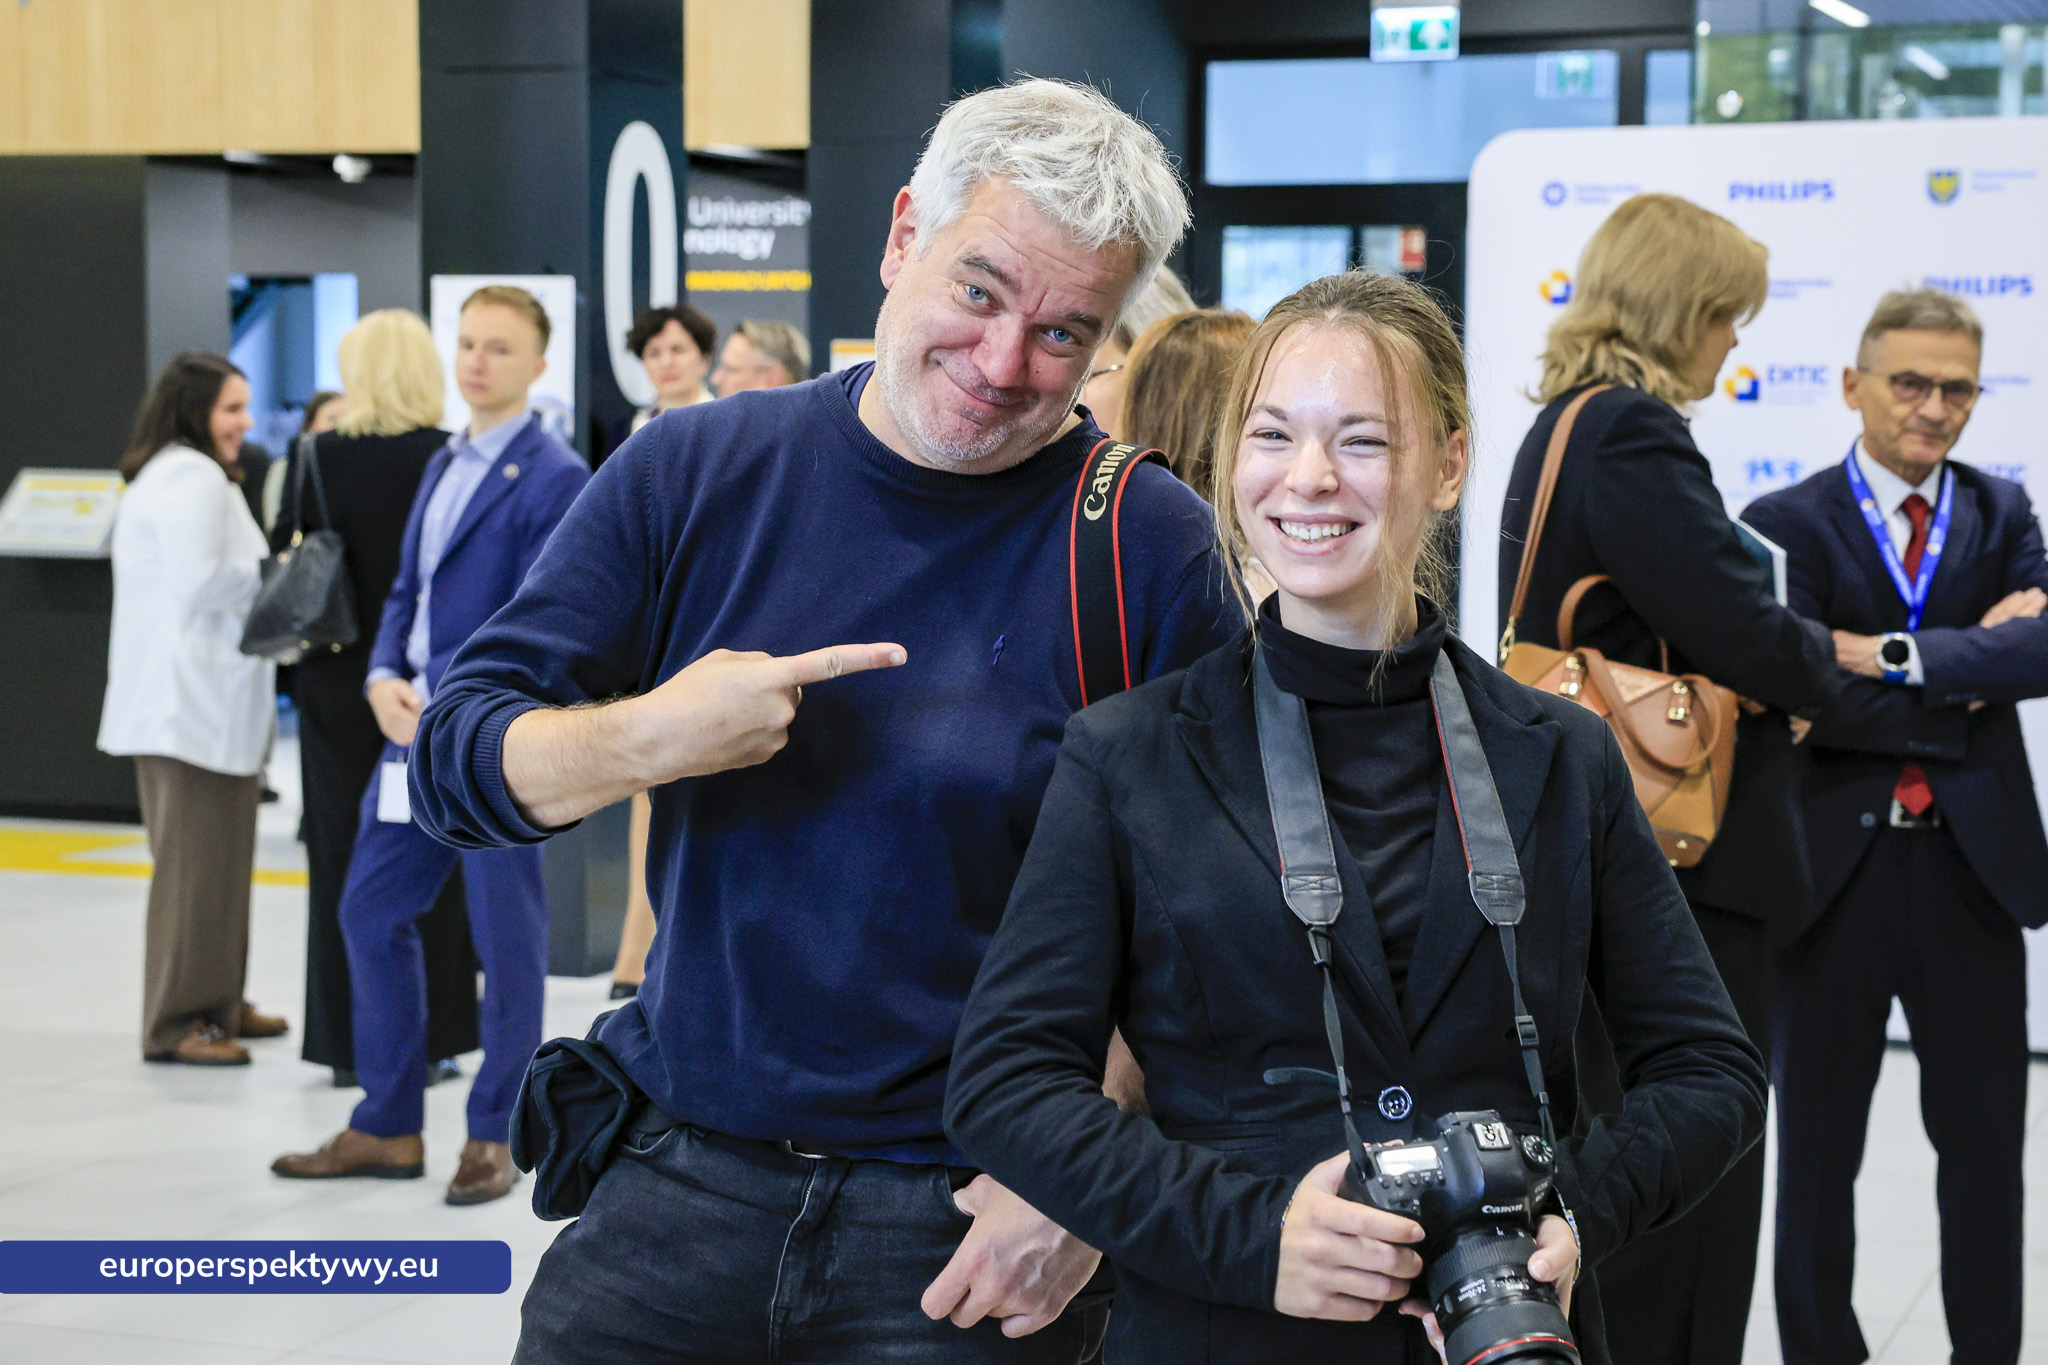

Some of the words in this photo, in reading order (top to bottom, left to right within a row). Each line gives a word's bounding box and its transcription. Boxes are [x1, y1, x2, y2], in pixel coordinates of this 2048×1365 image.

[1728, 182, 1834, 200] PHILIPS
[1083, 444, 1136, 521] Canon
[1482, 1204, 1523, 1214] Canon
